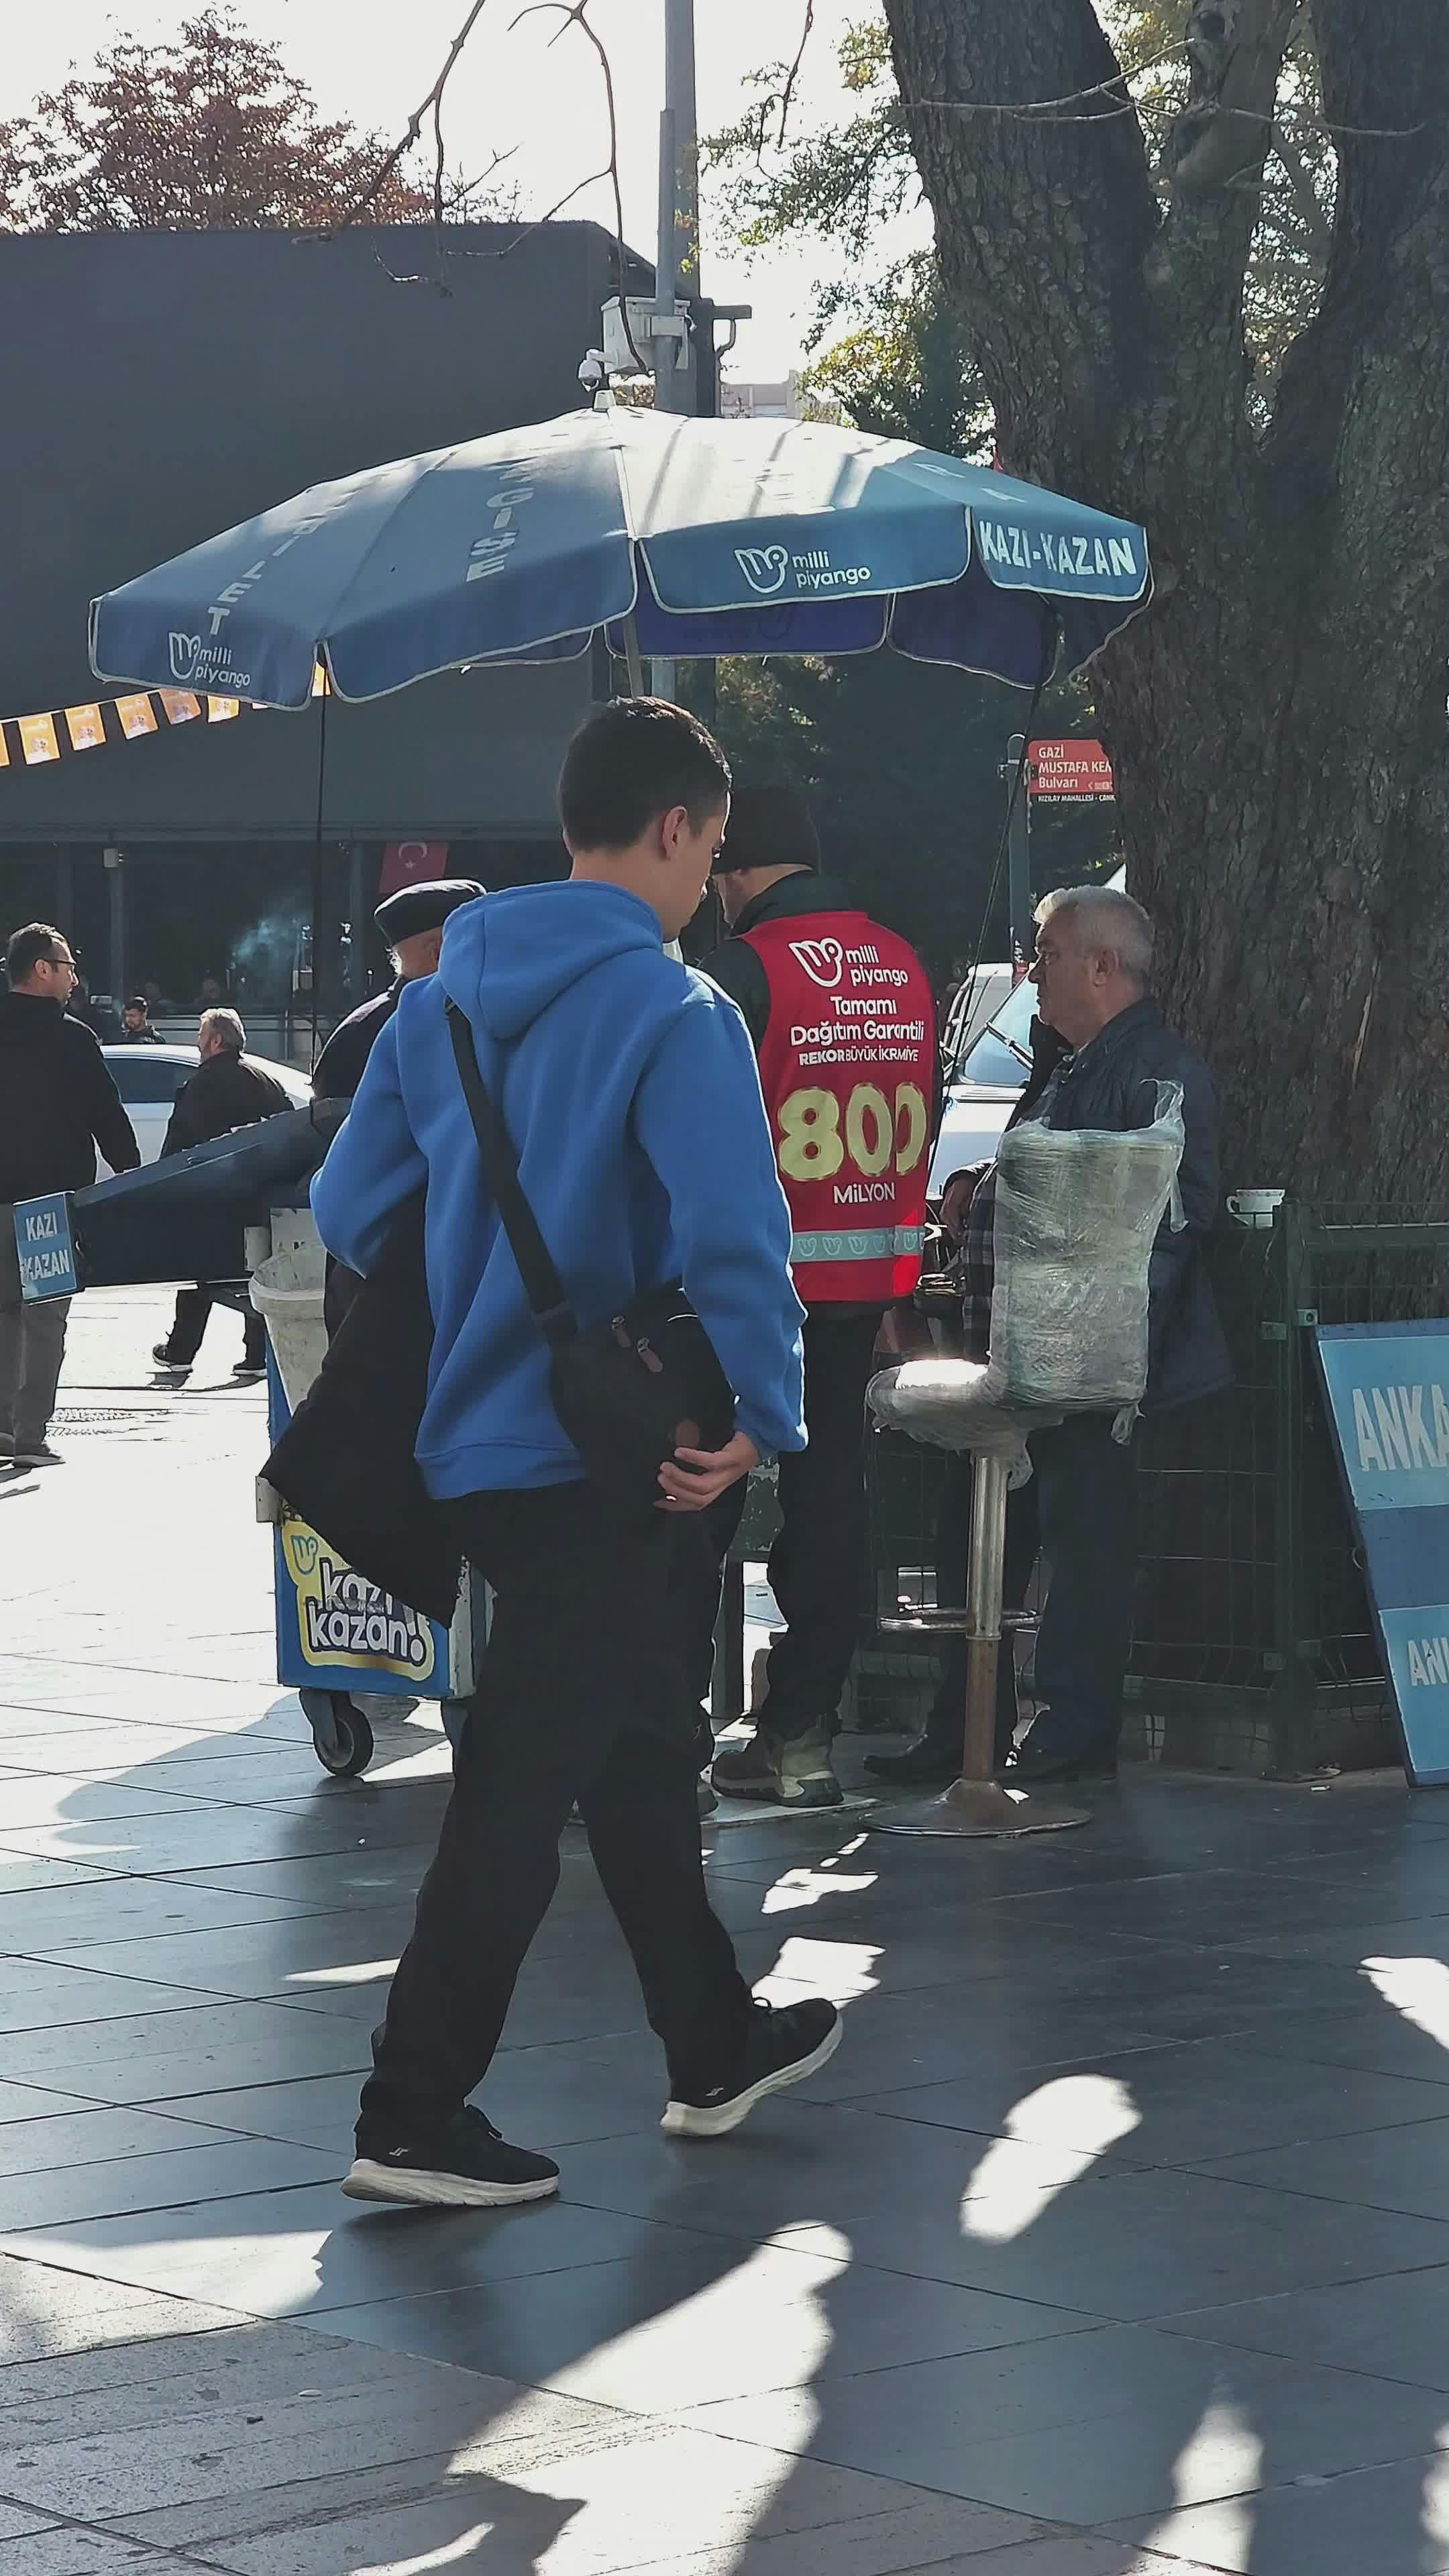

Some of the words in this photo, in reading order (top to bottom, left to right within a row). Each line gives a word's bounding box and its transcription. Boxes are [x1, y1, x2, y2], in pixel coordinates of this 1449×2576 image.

[792, 551, 830, 568] milli
[796, 567, 871, 589] piyango
[200, 646, 231, 665] milli
[195, 664, 250, 688] piyango
[1038, 744, 1063, 758] GAZİ
[1038, 761, 1089, 773] MUSTAFA
[1039, 777, 1078, 788] Bulvarı
[845, 945, 879, 963] milli
[850, 965, 908, 986] piyango
[830, 996, 897, 1015] Tamamı
[790, 1020, 861, 1046] Dağıtım
[863, 1020, 924, 1041] Garantili
[799, 1049, 845, 1066] REKOR
[845, 1045, 878, 1061] BÜYÜK
[777, 1081, 927, 1182] 800
[25, 1212, 58, 1241] KAZI
[22, 1249, 70, 1280] KAZAN
